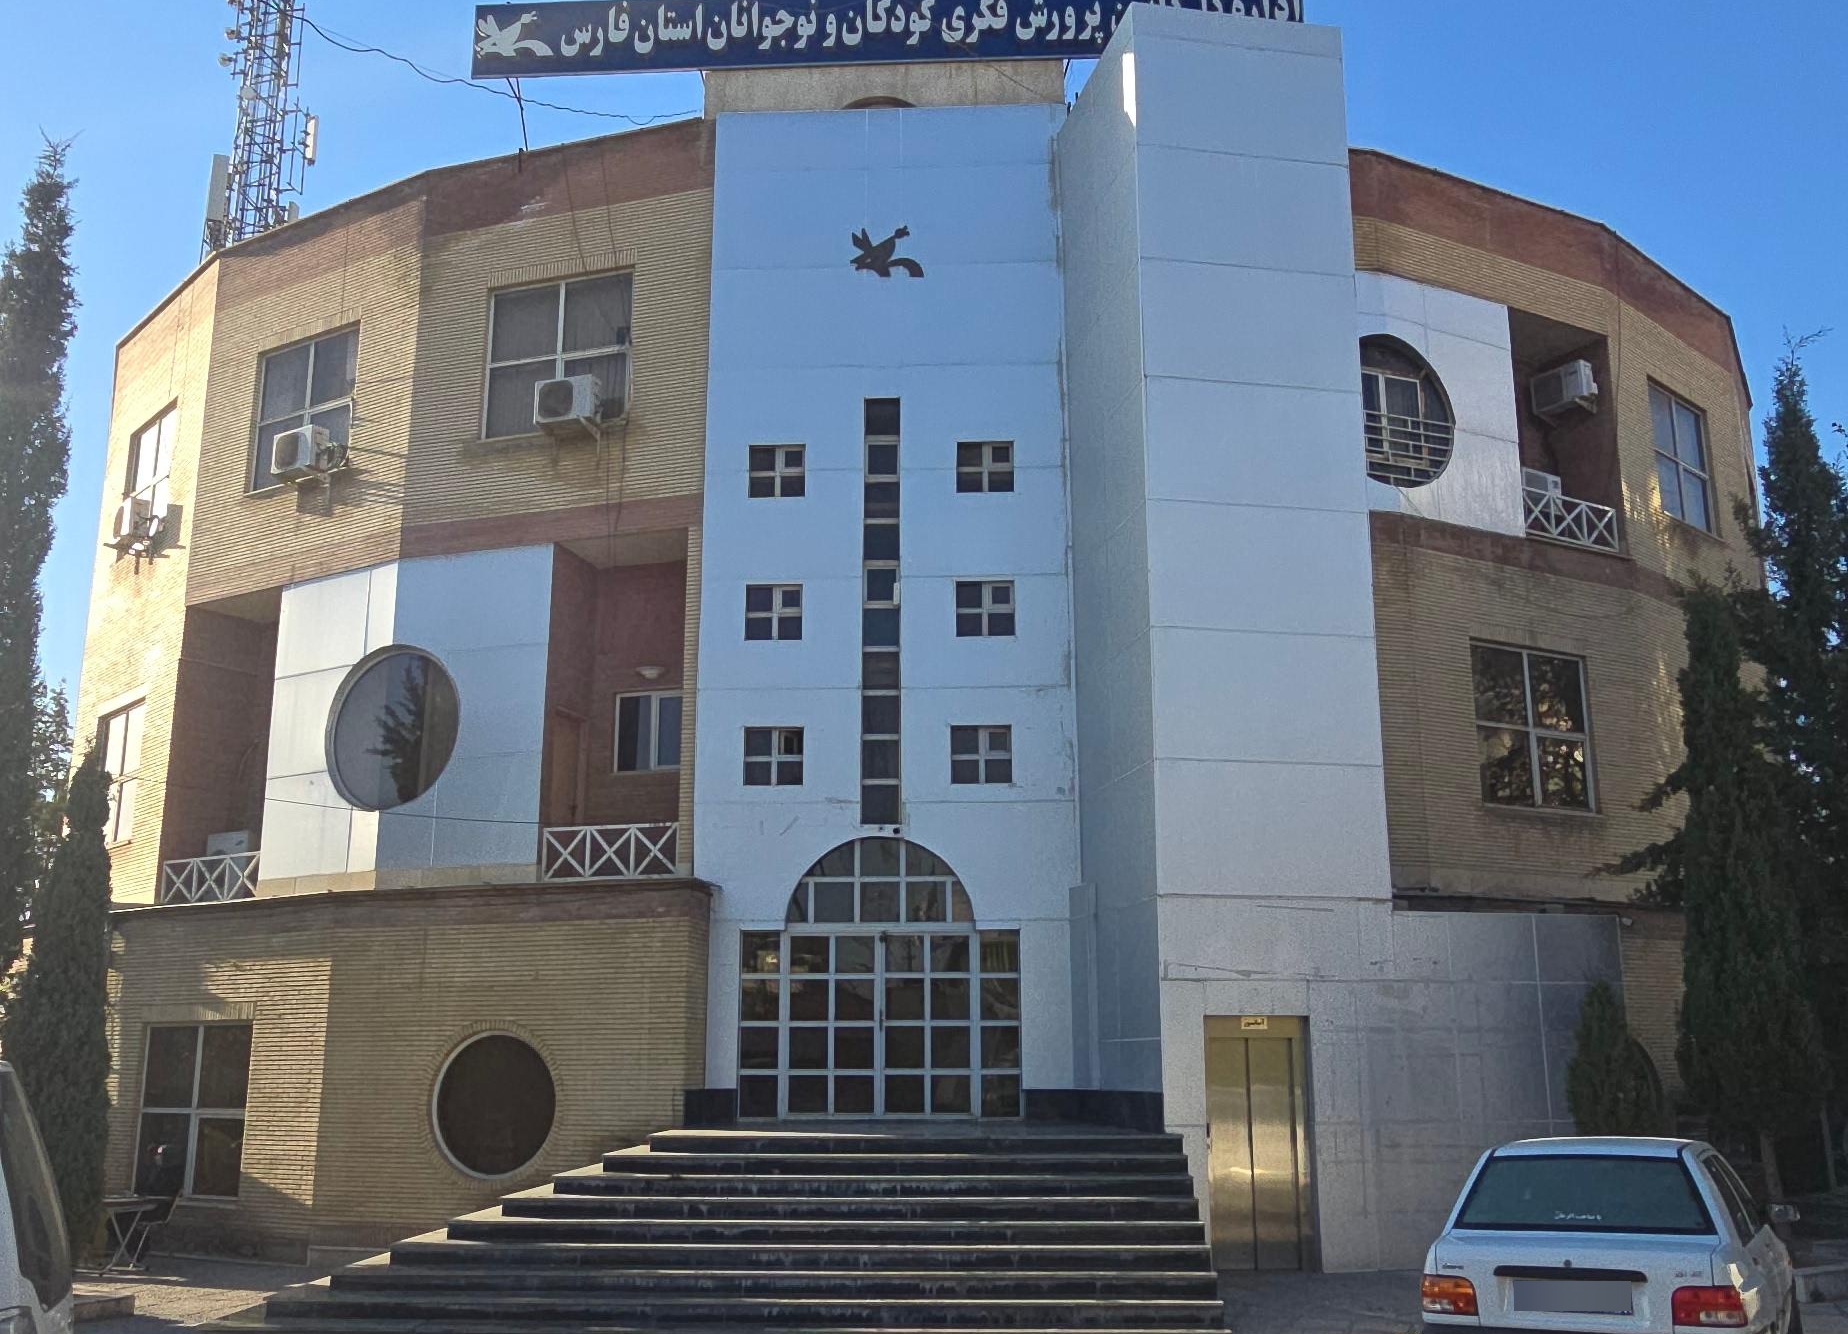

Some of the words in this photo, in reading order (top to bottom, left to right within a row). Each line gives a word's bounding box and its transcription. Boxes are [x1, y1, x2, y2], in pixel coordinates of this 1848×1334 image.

[560, 0, 630, 57] فارس
[634, 3, 703, 54] استان
[822, 13, 837, 47] و
